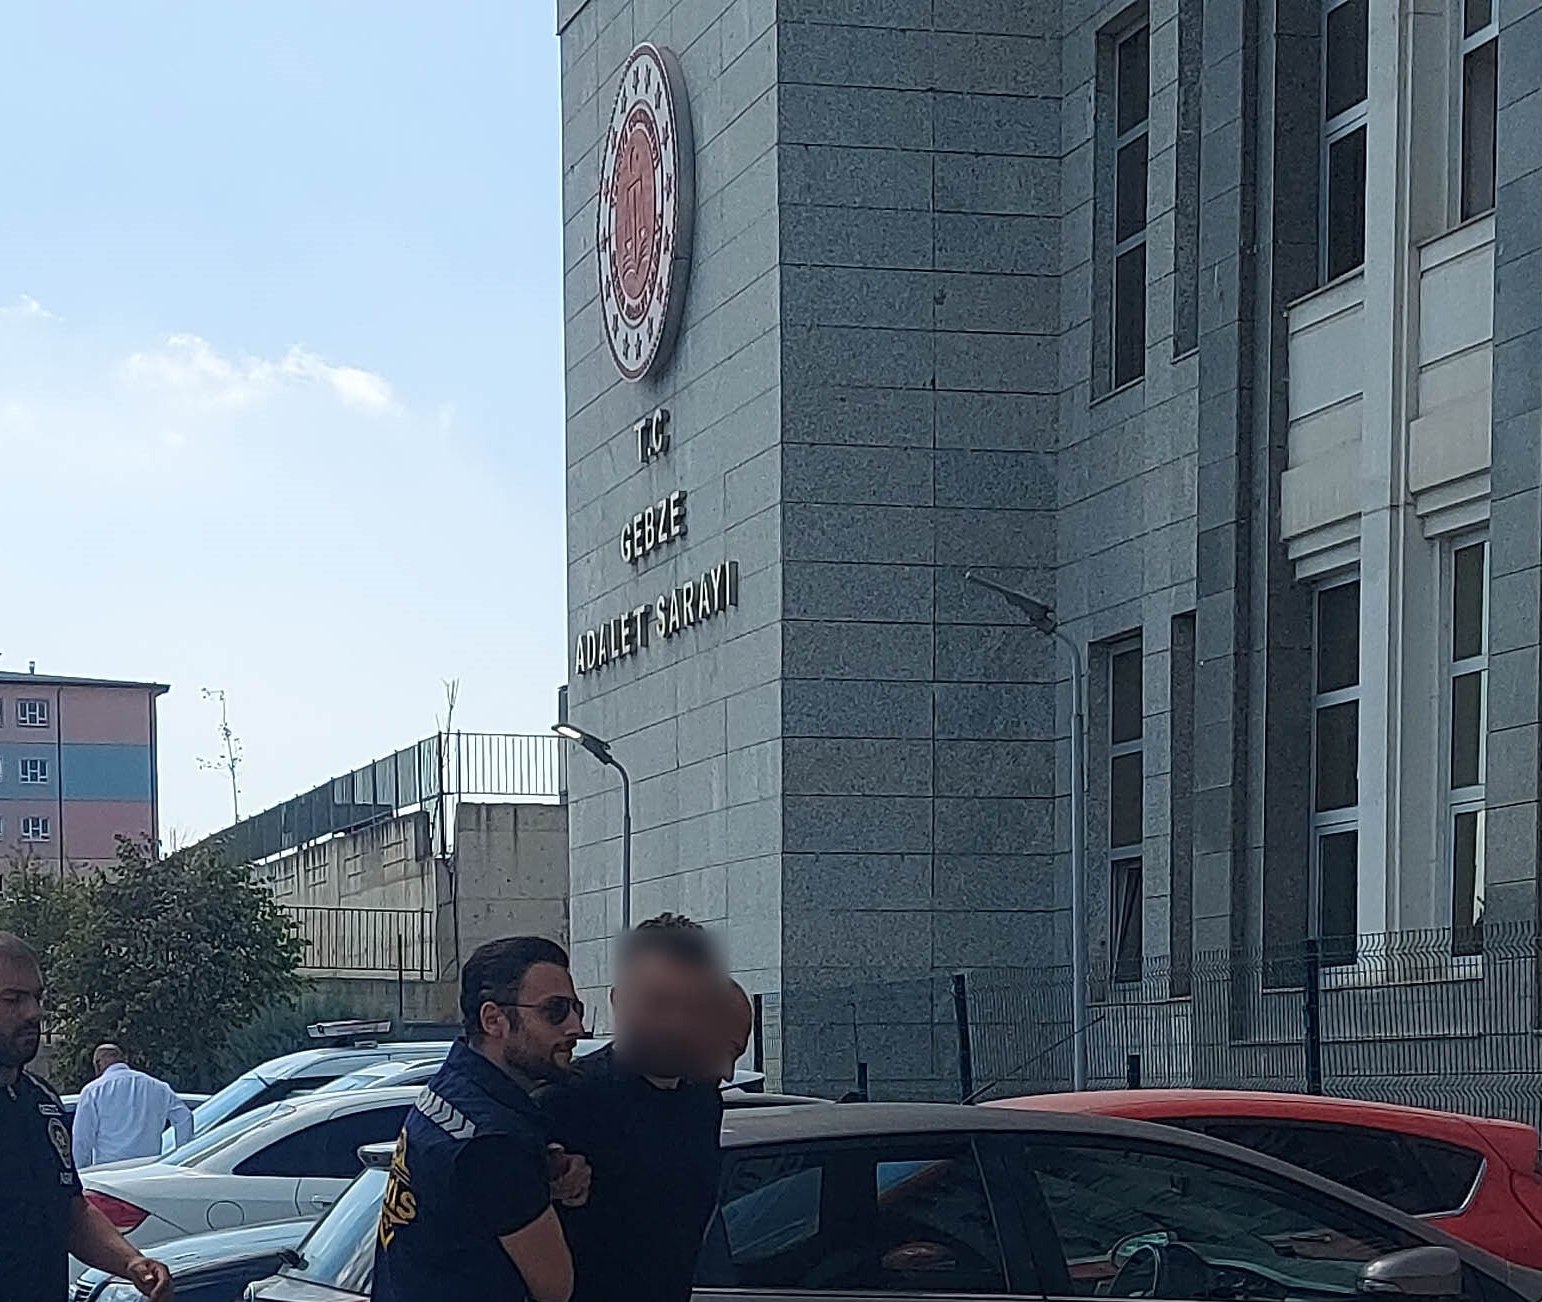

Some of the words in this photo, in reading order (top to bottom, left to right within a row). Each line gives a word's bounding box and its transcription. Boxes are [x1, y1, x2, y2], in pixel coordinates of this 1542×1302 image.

[620, 491, 686, 563] GEBZE
[575, 604, 651, 675] ADALET
[657, 560, 736, 637] SARAYI
